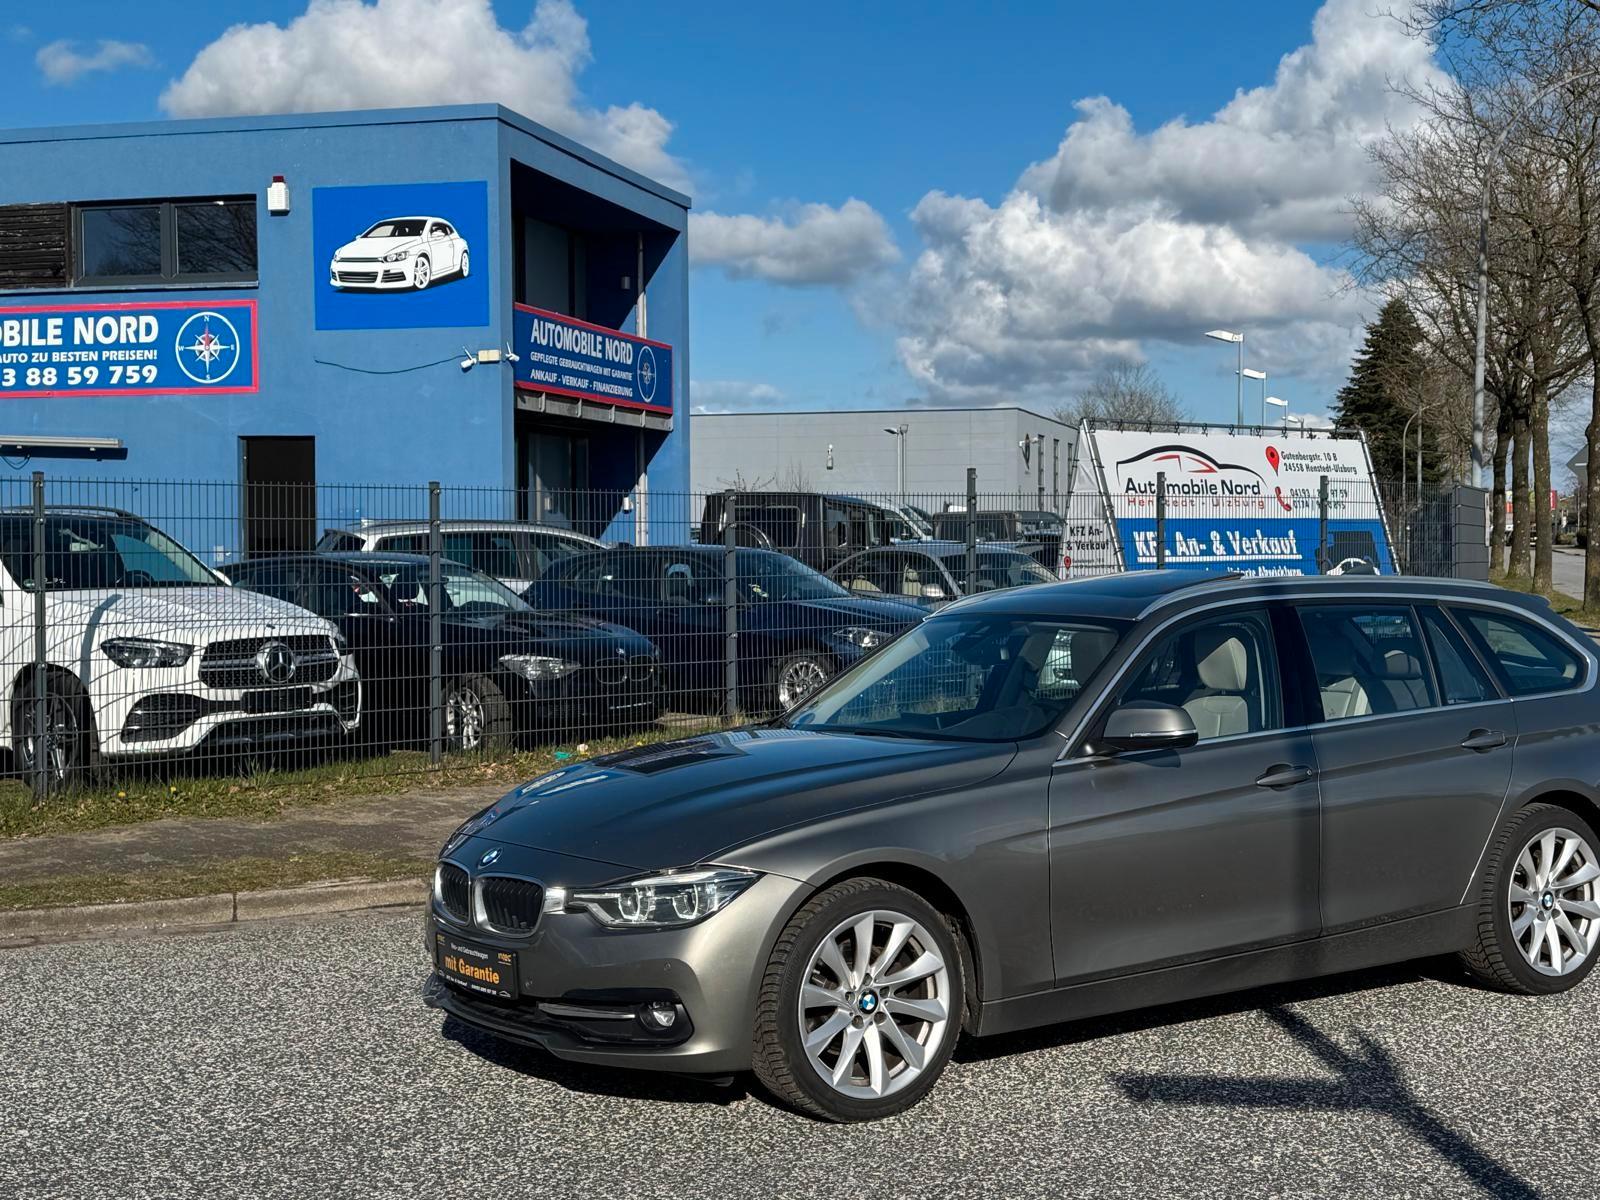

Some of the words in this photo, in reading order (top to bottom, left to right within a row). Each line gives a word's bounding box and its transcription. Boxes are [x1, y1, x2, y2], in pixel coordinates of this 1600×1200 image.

[0, 318, 63, 347] BILE
[74, 315, 159, 345] NORD
[530, 318, 603, 358] AUTOMOBILE
[605, 337, 633, 365] NORD
[31, 352, 49, 363] ZU
[52, 351, 99, 362] BESTEN
[102, 349, 158, 361] PREISEN!
[26, 367, 58, 386] 88
[67, 366, 99, 385] 59
[109, 365, 158, 384] 759
[530, 351, 559, 366] GEPFLEGTE
[559, 358, 602, 375] GEBRAUCHTWAGEN
[602, 365, 611, 377] MIT
[611, 368, 633, 381] GARANTIE
[530, 368, 558, 383] ANKAUF
[561, 374, 589, 389] VERKAUF
[592, 380, 633, 397] FINANZIERUNG
[1281, 451, 1323, 462] Gutenbergstr.
[1324, 452, 1333, 461] 10
[1284, 463, 1304, 472] 24558
[1305, 464, 1358, 475] Henstedt-Ulzburg
[1125, 477, 1218, 495] Autmobile
[1220, 479, 1261, 495] Nord
[1127, 497, 1195, 508] Hentedt
[1211, 498, 1265, 509] Ulzburg
[1070, 526, 1085, 536] KFZ
[1088, 526, 1103, 536] An-
[1075, 539, 1109, 550] Verkauf
[1175, 531, 1206, 556] An-
[1210, 530, 1226, 556] &
[1226, 529, 1297, 555] Verkauf
[445, 954, 457, 971] mit
[458, 958, 500, 984] Garantie
